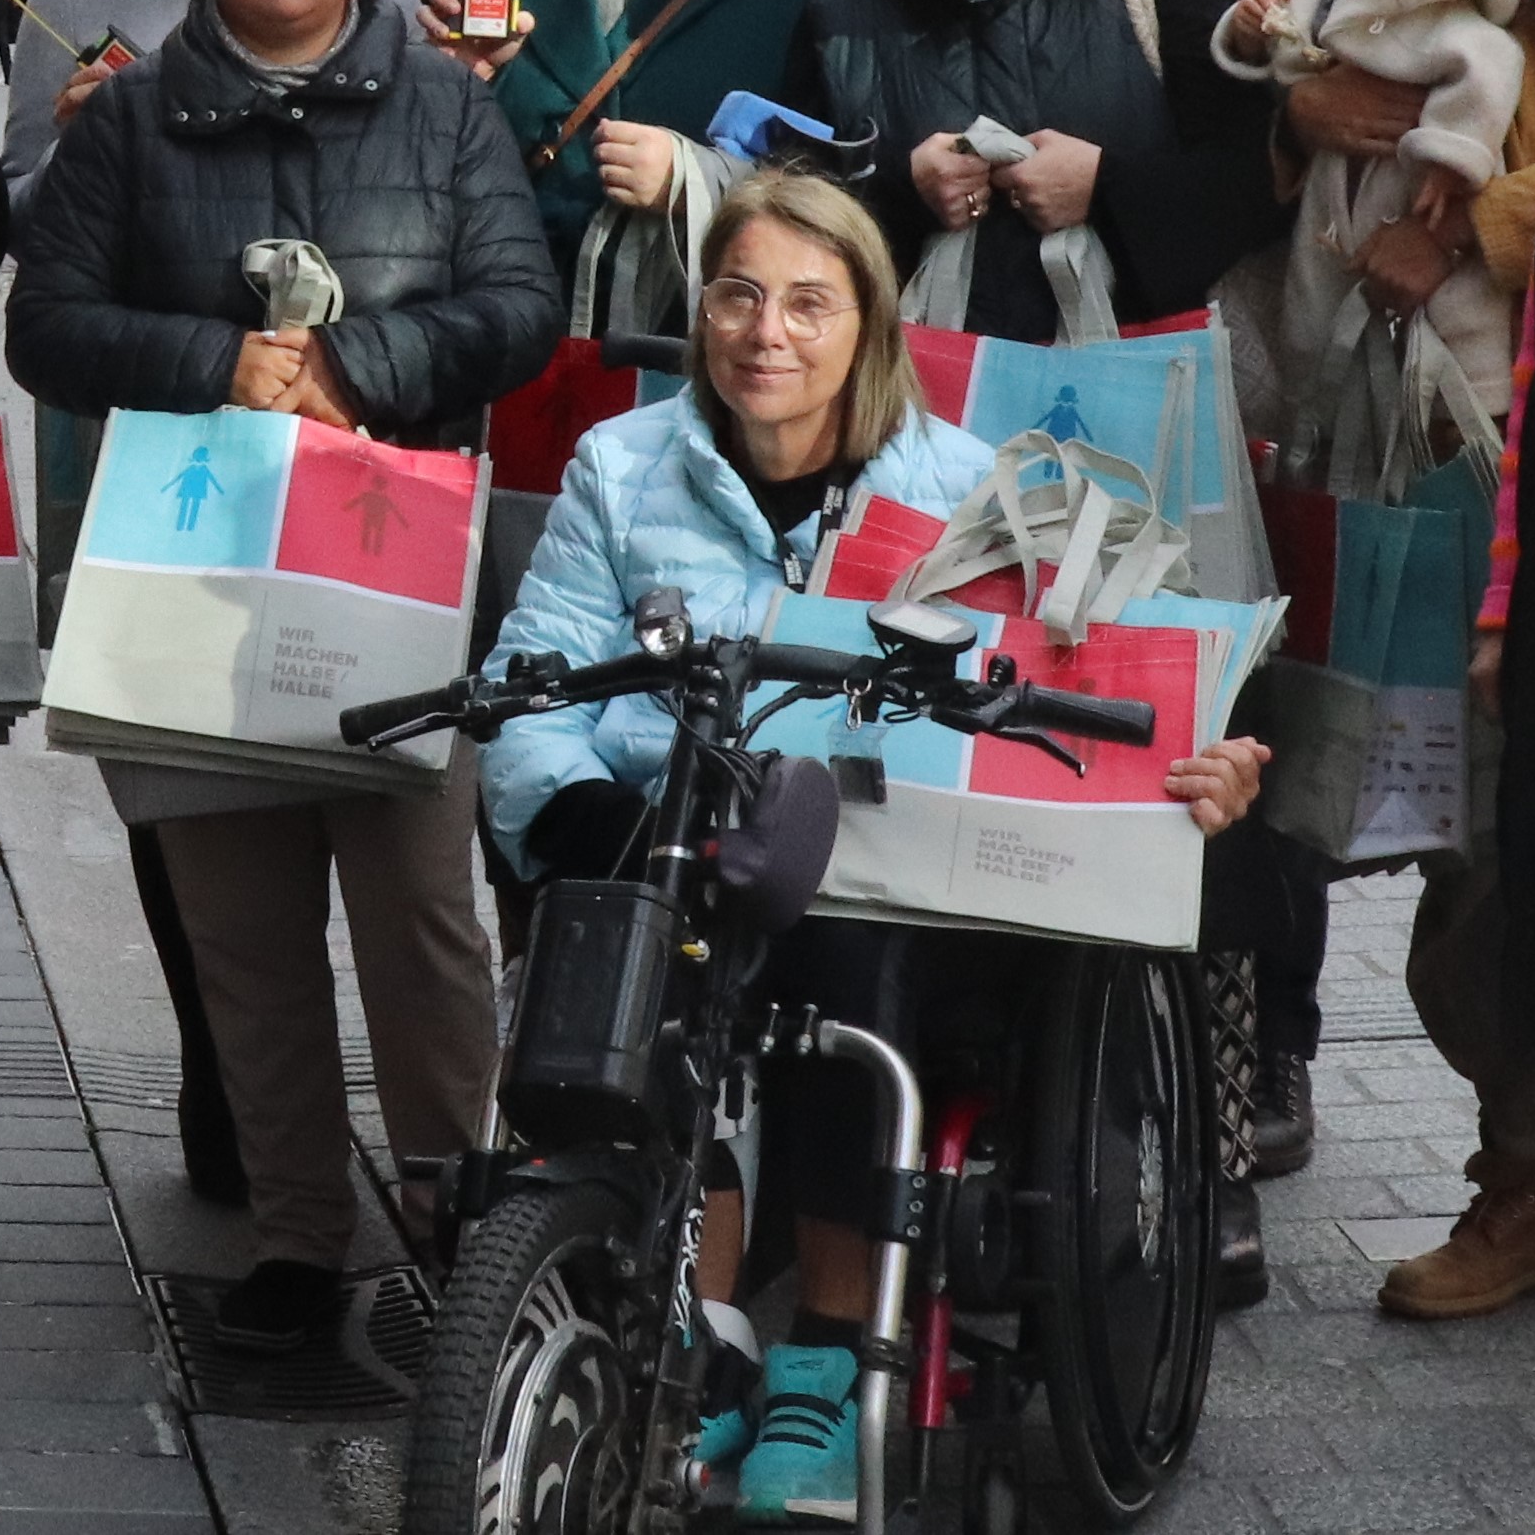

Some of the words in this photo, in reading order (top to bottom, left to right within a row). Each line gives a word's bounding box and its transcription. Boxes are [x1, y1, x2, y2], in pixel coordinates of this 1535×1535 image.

[274, 643, 359, 667] MACHEN
[269, 679, 333, 700] HALBE
[977, 839, 1076, 866] MACHEN
